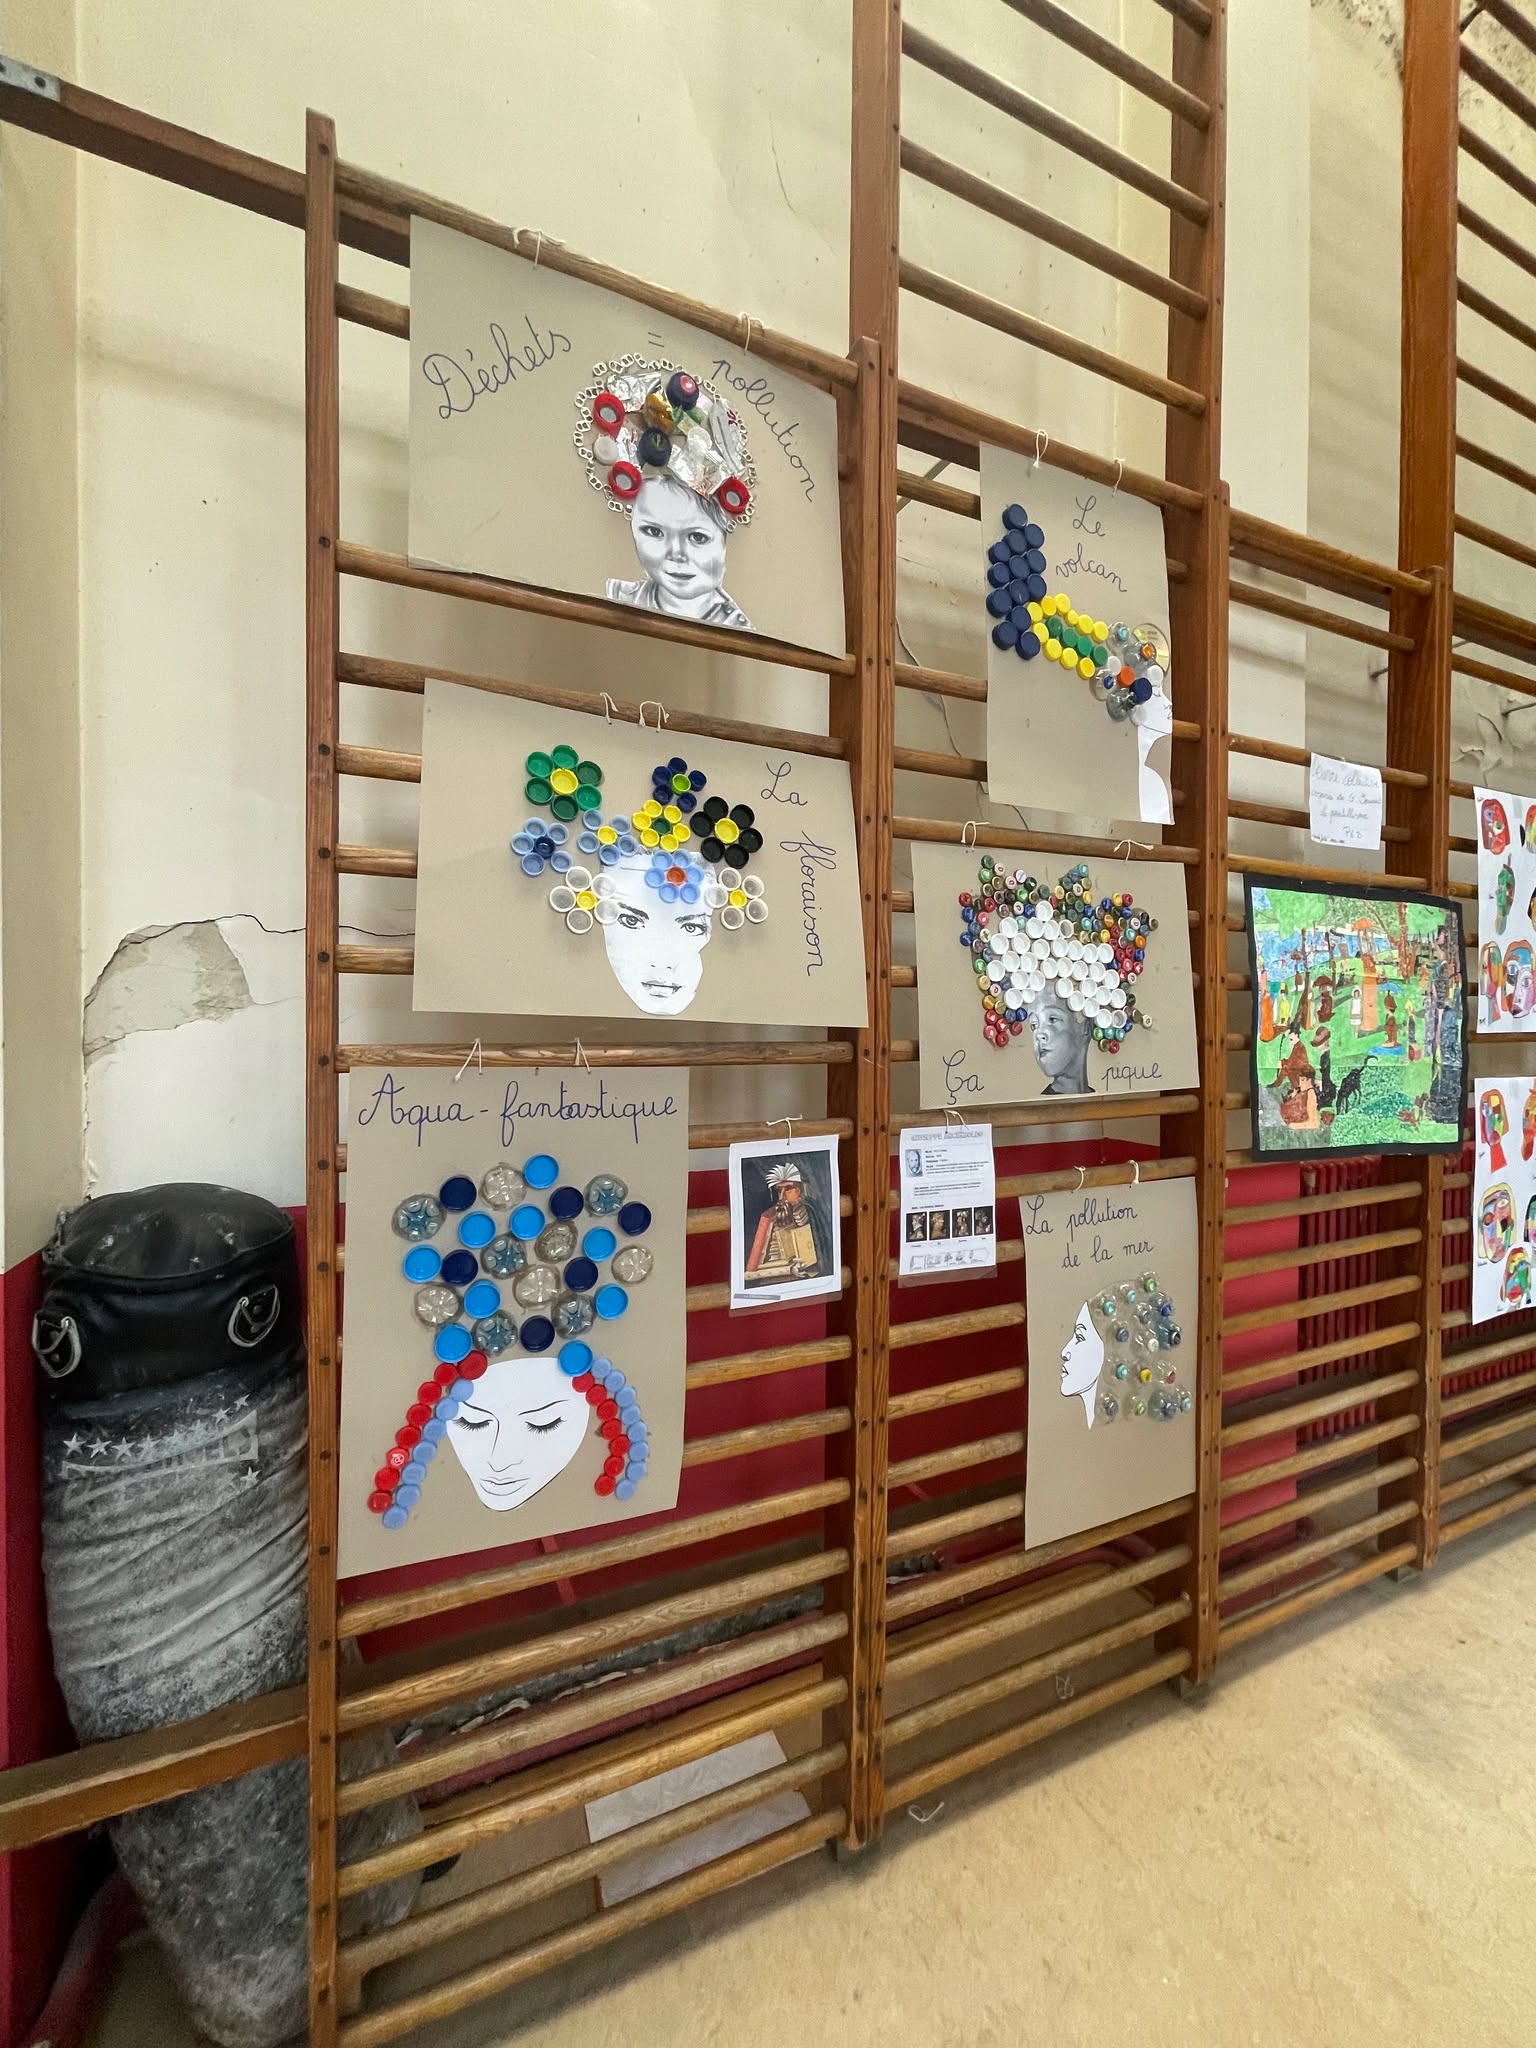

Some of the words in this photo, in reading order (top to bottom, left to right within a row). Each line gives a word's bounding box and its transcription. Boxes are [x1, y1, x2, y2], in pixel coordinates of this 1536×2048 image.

[422, 316, 571, 419] Déchets
[712, 360, 816, 503] pollution
[1072, 495, 1106, 537] Le
[1055, 542, 1127, 593] volcan
[760, 761, 808, 806] La
[779, 830, 837, 977] floraison
[942, 1049, 985, 1106] Ça
[1101, 1062, 1162, 1091] pique
[358, 1073, 474, 1147] Aqua
[499, 1080, 678, 1148] fantastique
[1025, 1194, 1054, 1235] La
[1066, 1198, 1138, 1242] pollution
[1062, 1242, 1081, 1269] de
[1090, 1235, 1113, 1264] la
[1122, 1240, 1154, 1257] mer
